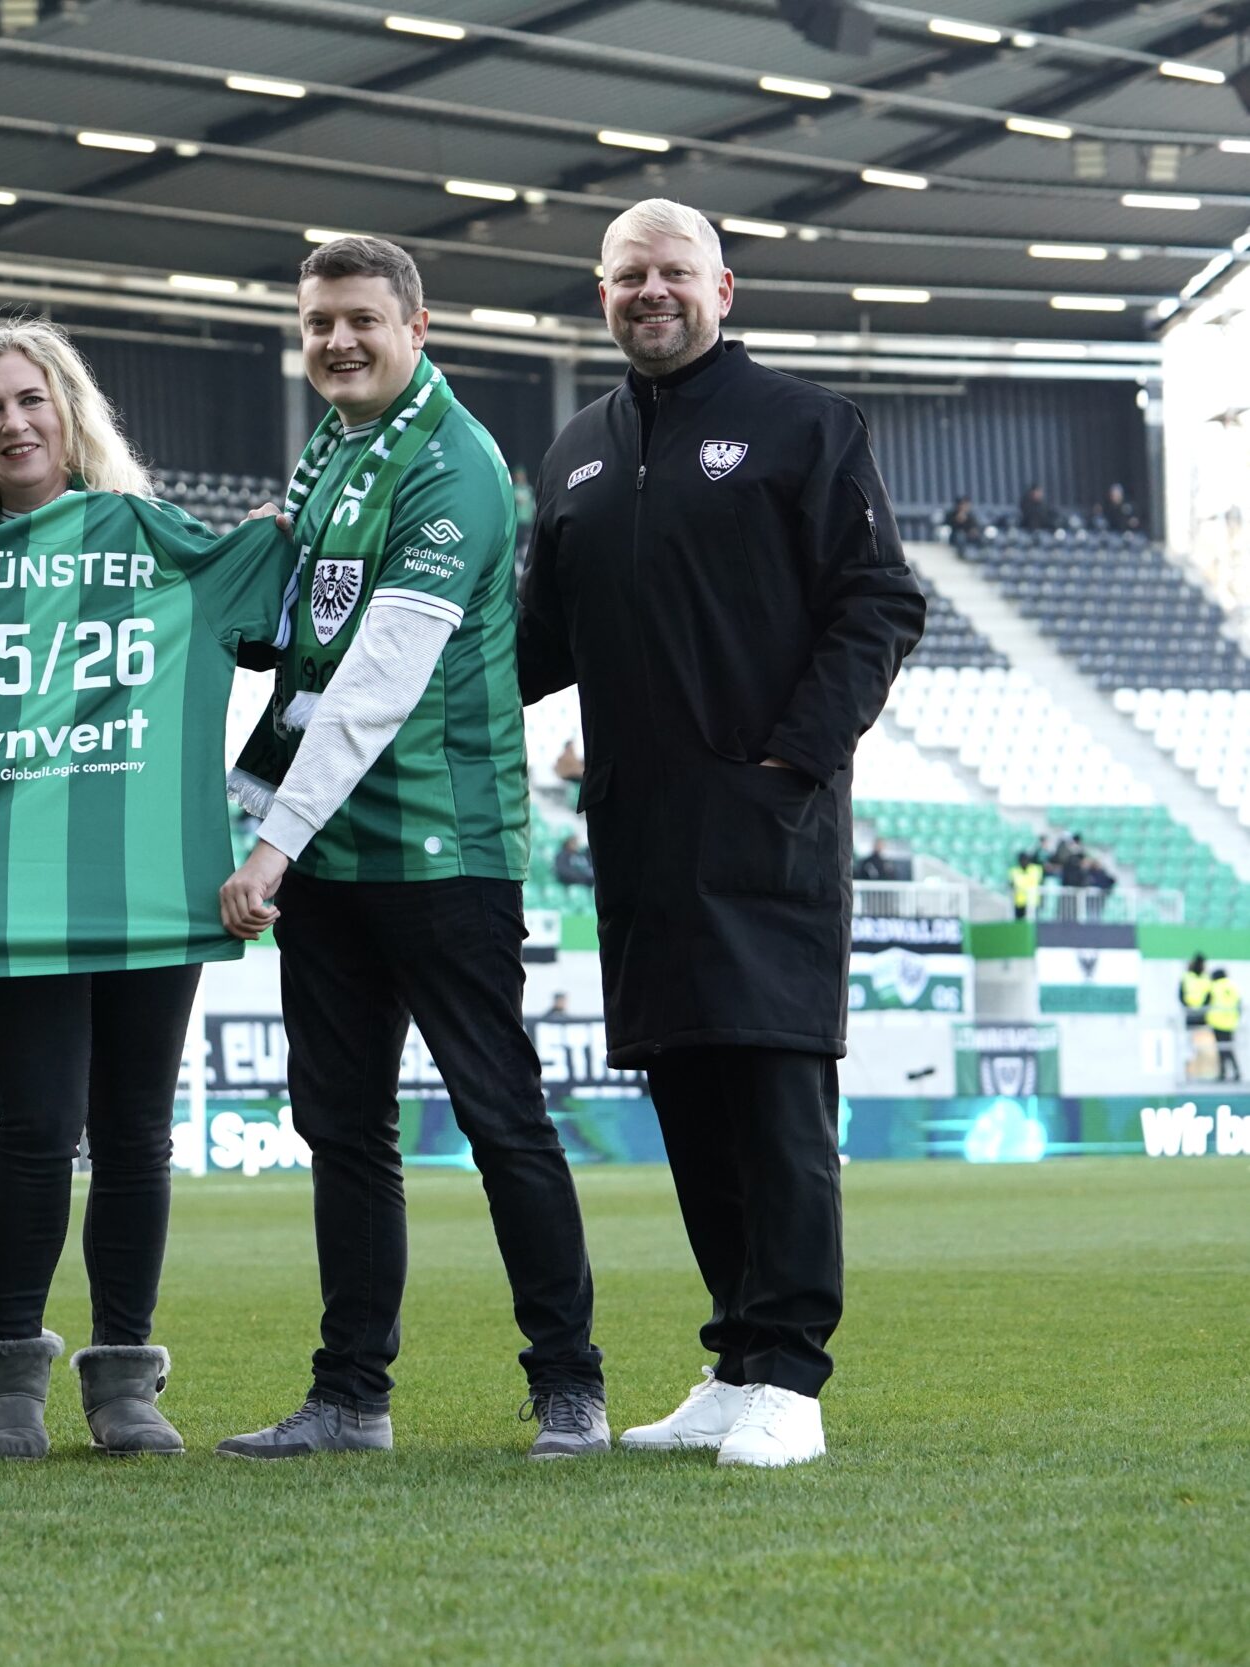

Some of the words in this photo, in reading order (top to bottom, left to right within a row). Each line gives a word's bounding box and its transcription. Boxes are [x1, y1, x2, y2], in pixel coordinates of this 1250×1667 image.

[404, 558, 454, 579] Münster
[318, 625, 333, 636] 1906
[0, 763, 80, 781] GlobalLogic
[82, 761, 146, 774] company
[1140, 1102, 1214, 1157] Wir
